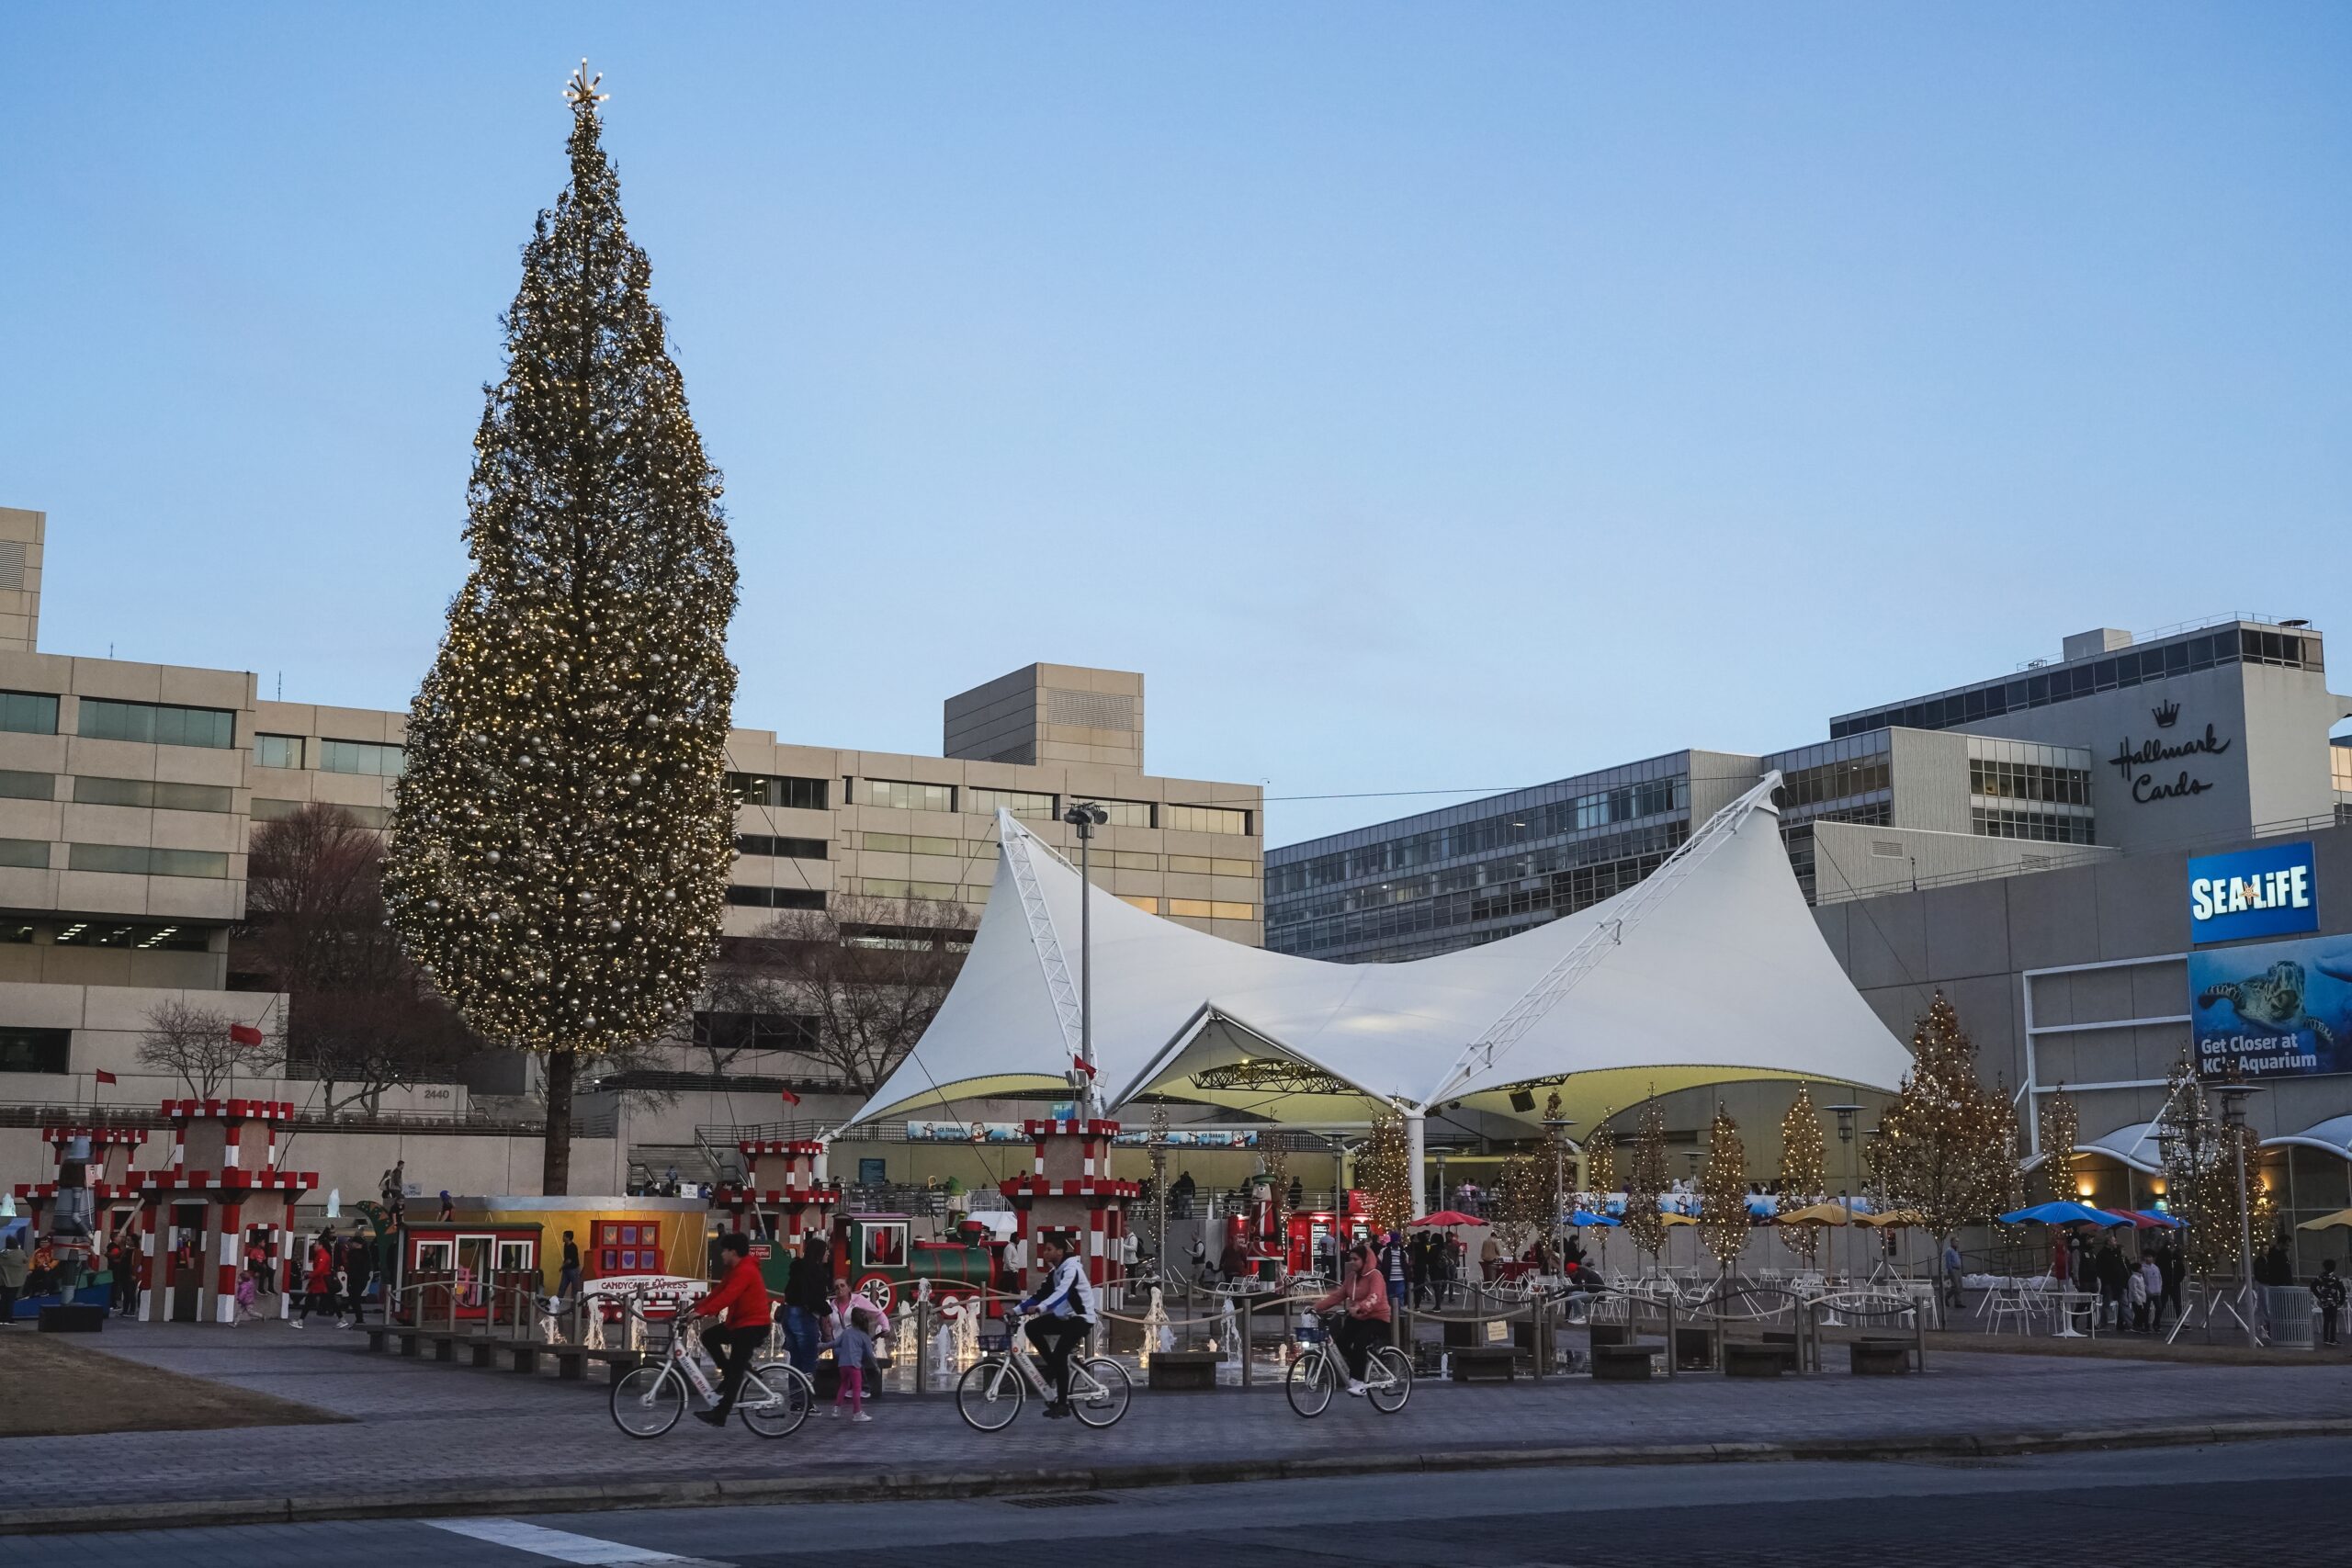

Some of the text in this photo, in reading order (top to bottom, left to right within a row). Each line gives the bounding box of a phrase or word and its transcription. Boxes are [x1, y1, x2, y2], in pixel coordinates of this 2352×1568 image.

[2108, 723, 2232, 782] Hallmark
[2132, 772, 2213, 804] Cards
[2192, 876, 2247, 920] SEA
[2201, 1032, 2299, 1055] Get Closer at
[2202, 1051, 2317, 1075] KC' Aquarium
[424, 1089, 450, 1100] 2440
